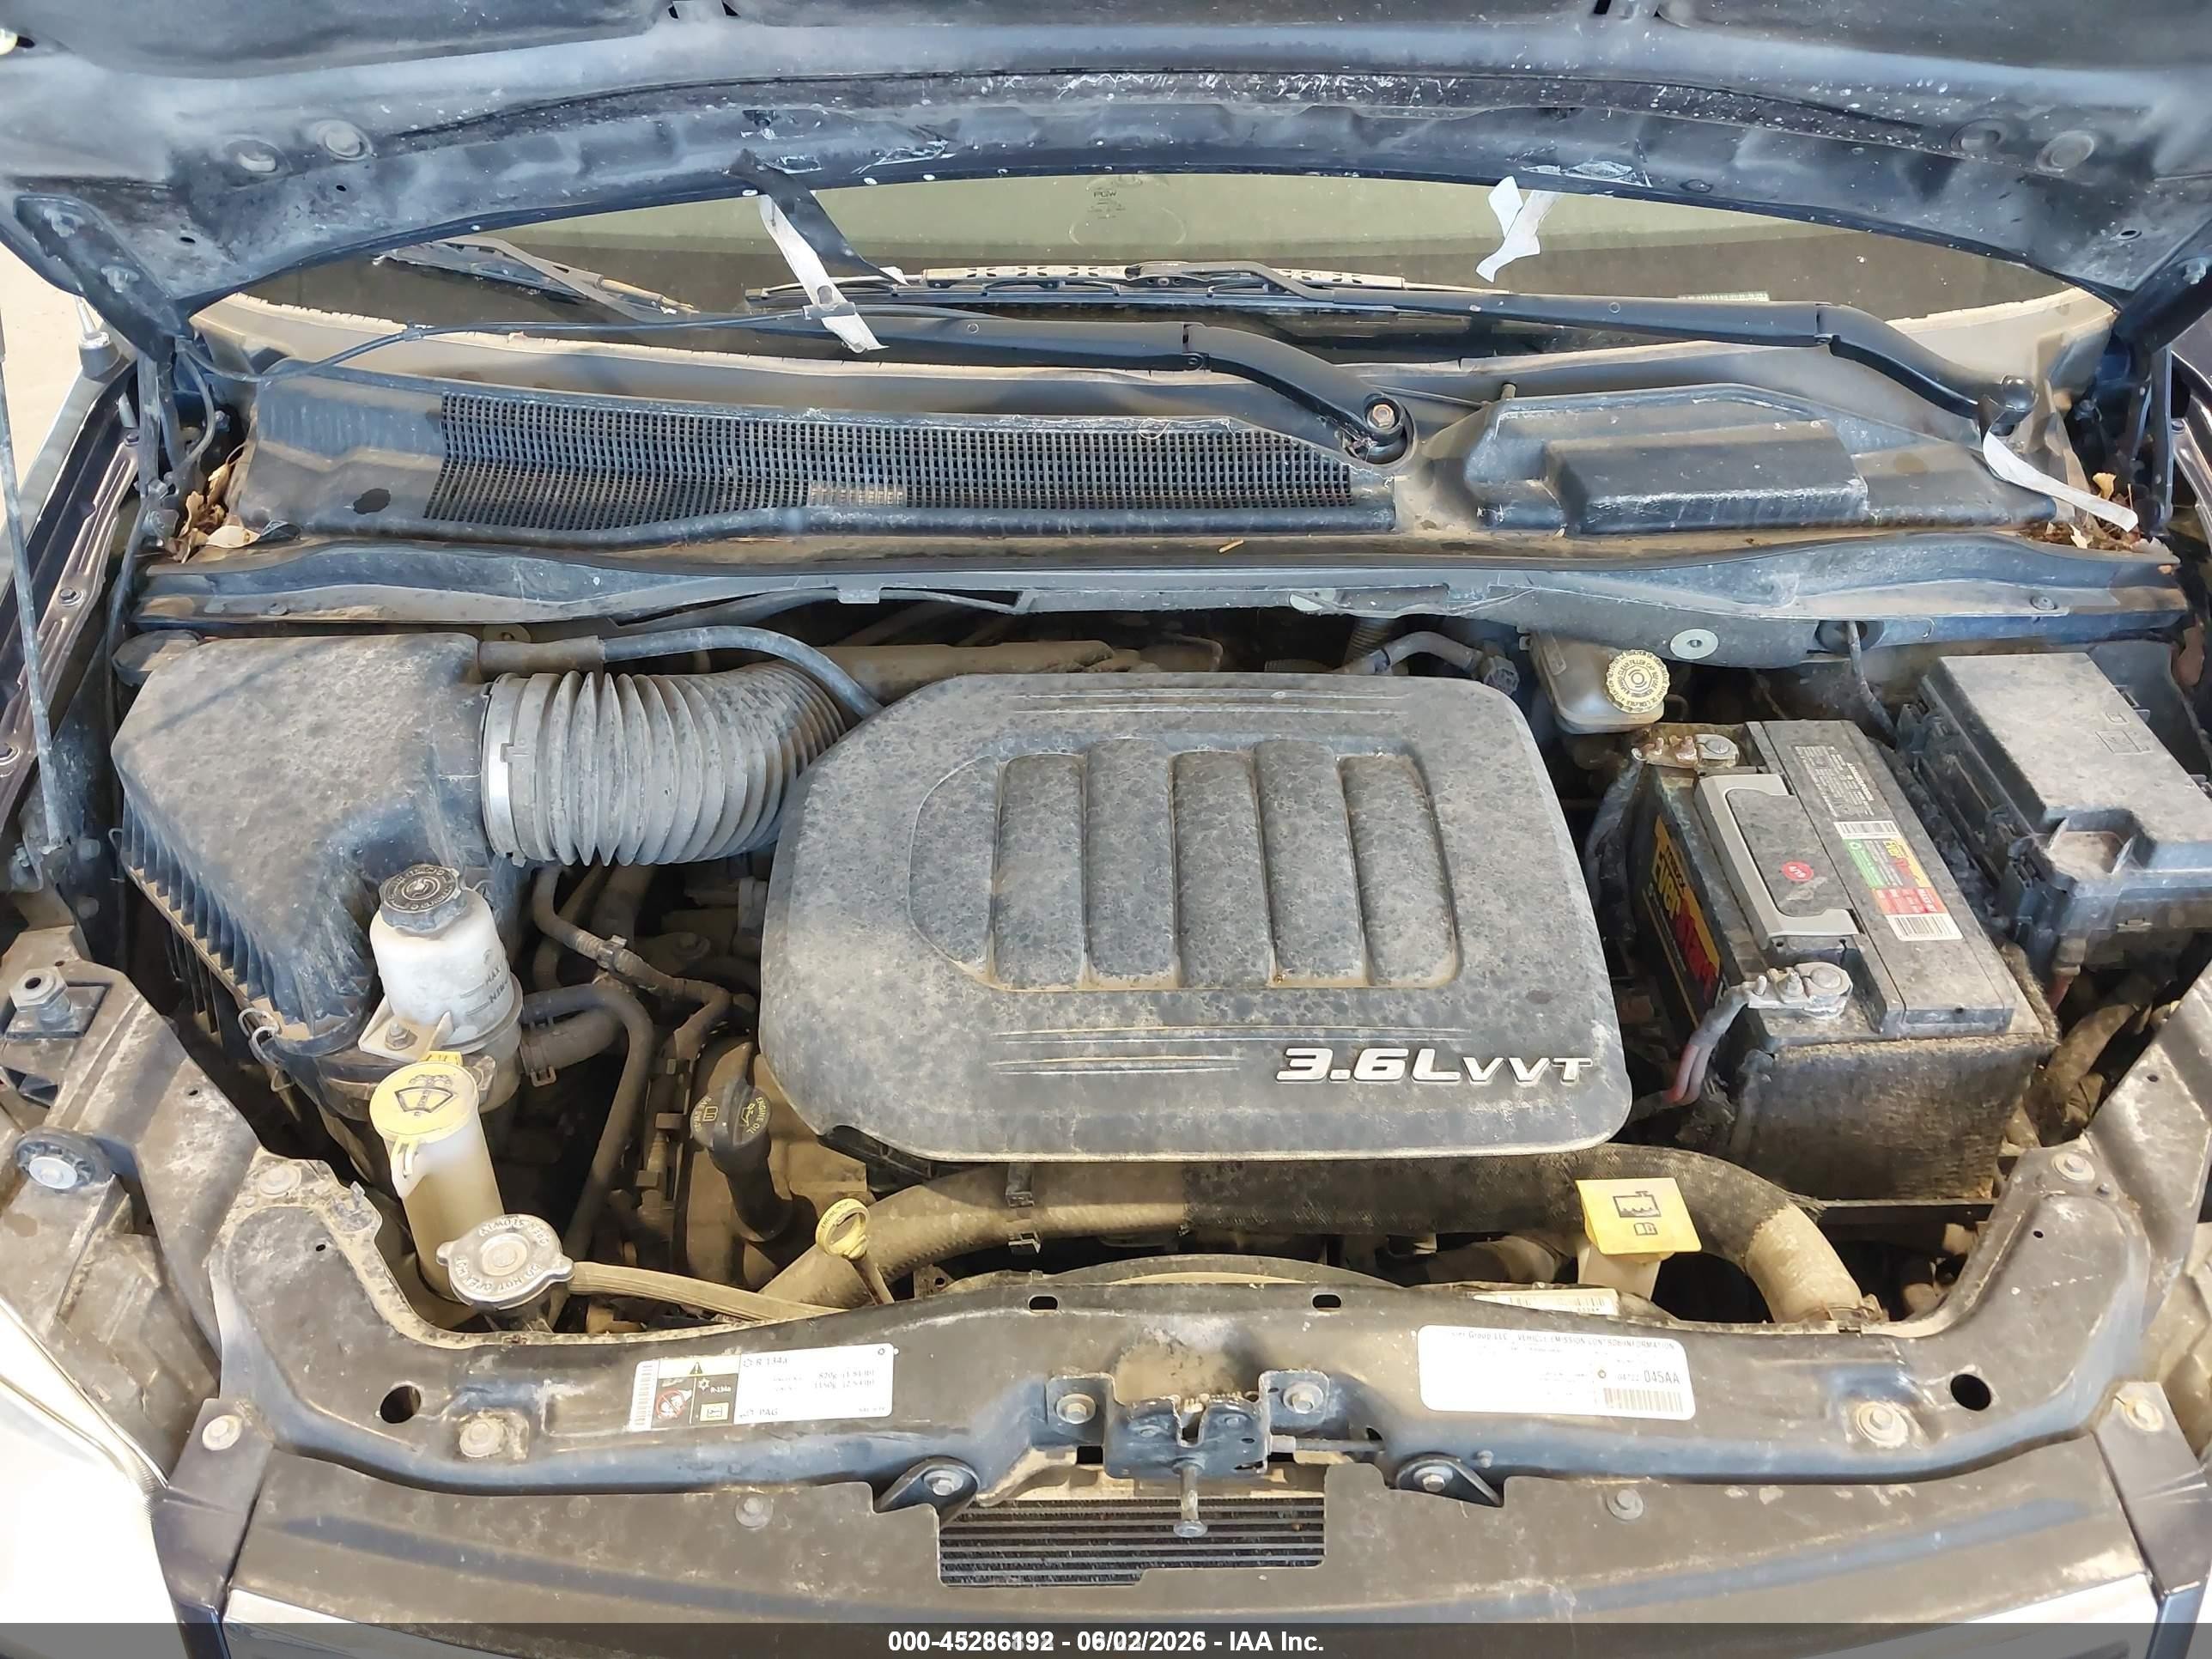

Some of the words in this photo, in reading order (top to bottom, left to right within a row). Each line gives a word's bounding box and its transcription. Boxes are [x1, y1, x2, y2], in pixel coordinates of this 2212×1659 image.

[1617, 661, 1630, 676] CLEAN
[1276, 1047, 1461, 1084] 3.6L
[1462, 1056, 1594, 1085] VVT
[755, 1096, 767, 1123] ENGINE
[745, 1122, 760, 1134] OIL
[497, 1277, 523, 1291] NOT
[1644, 1370, 1680, 1385] 045AA
